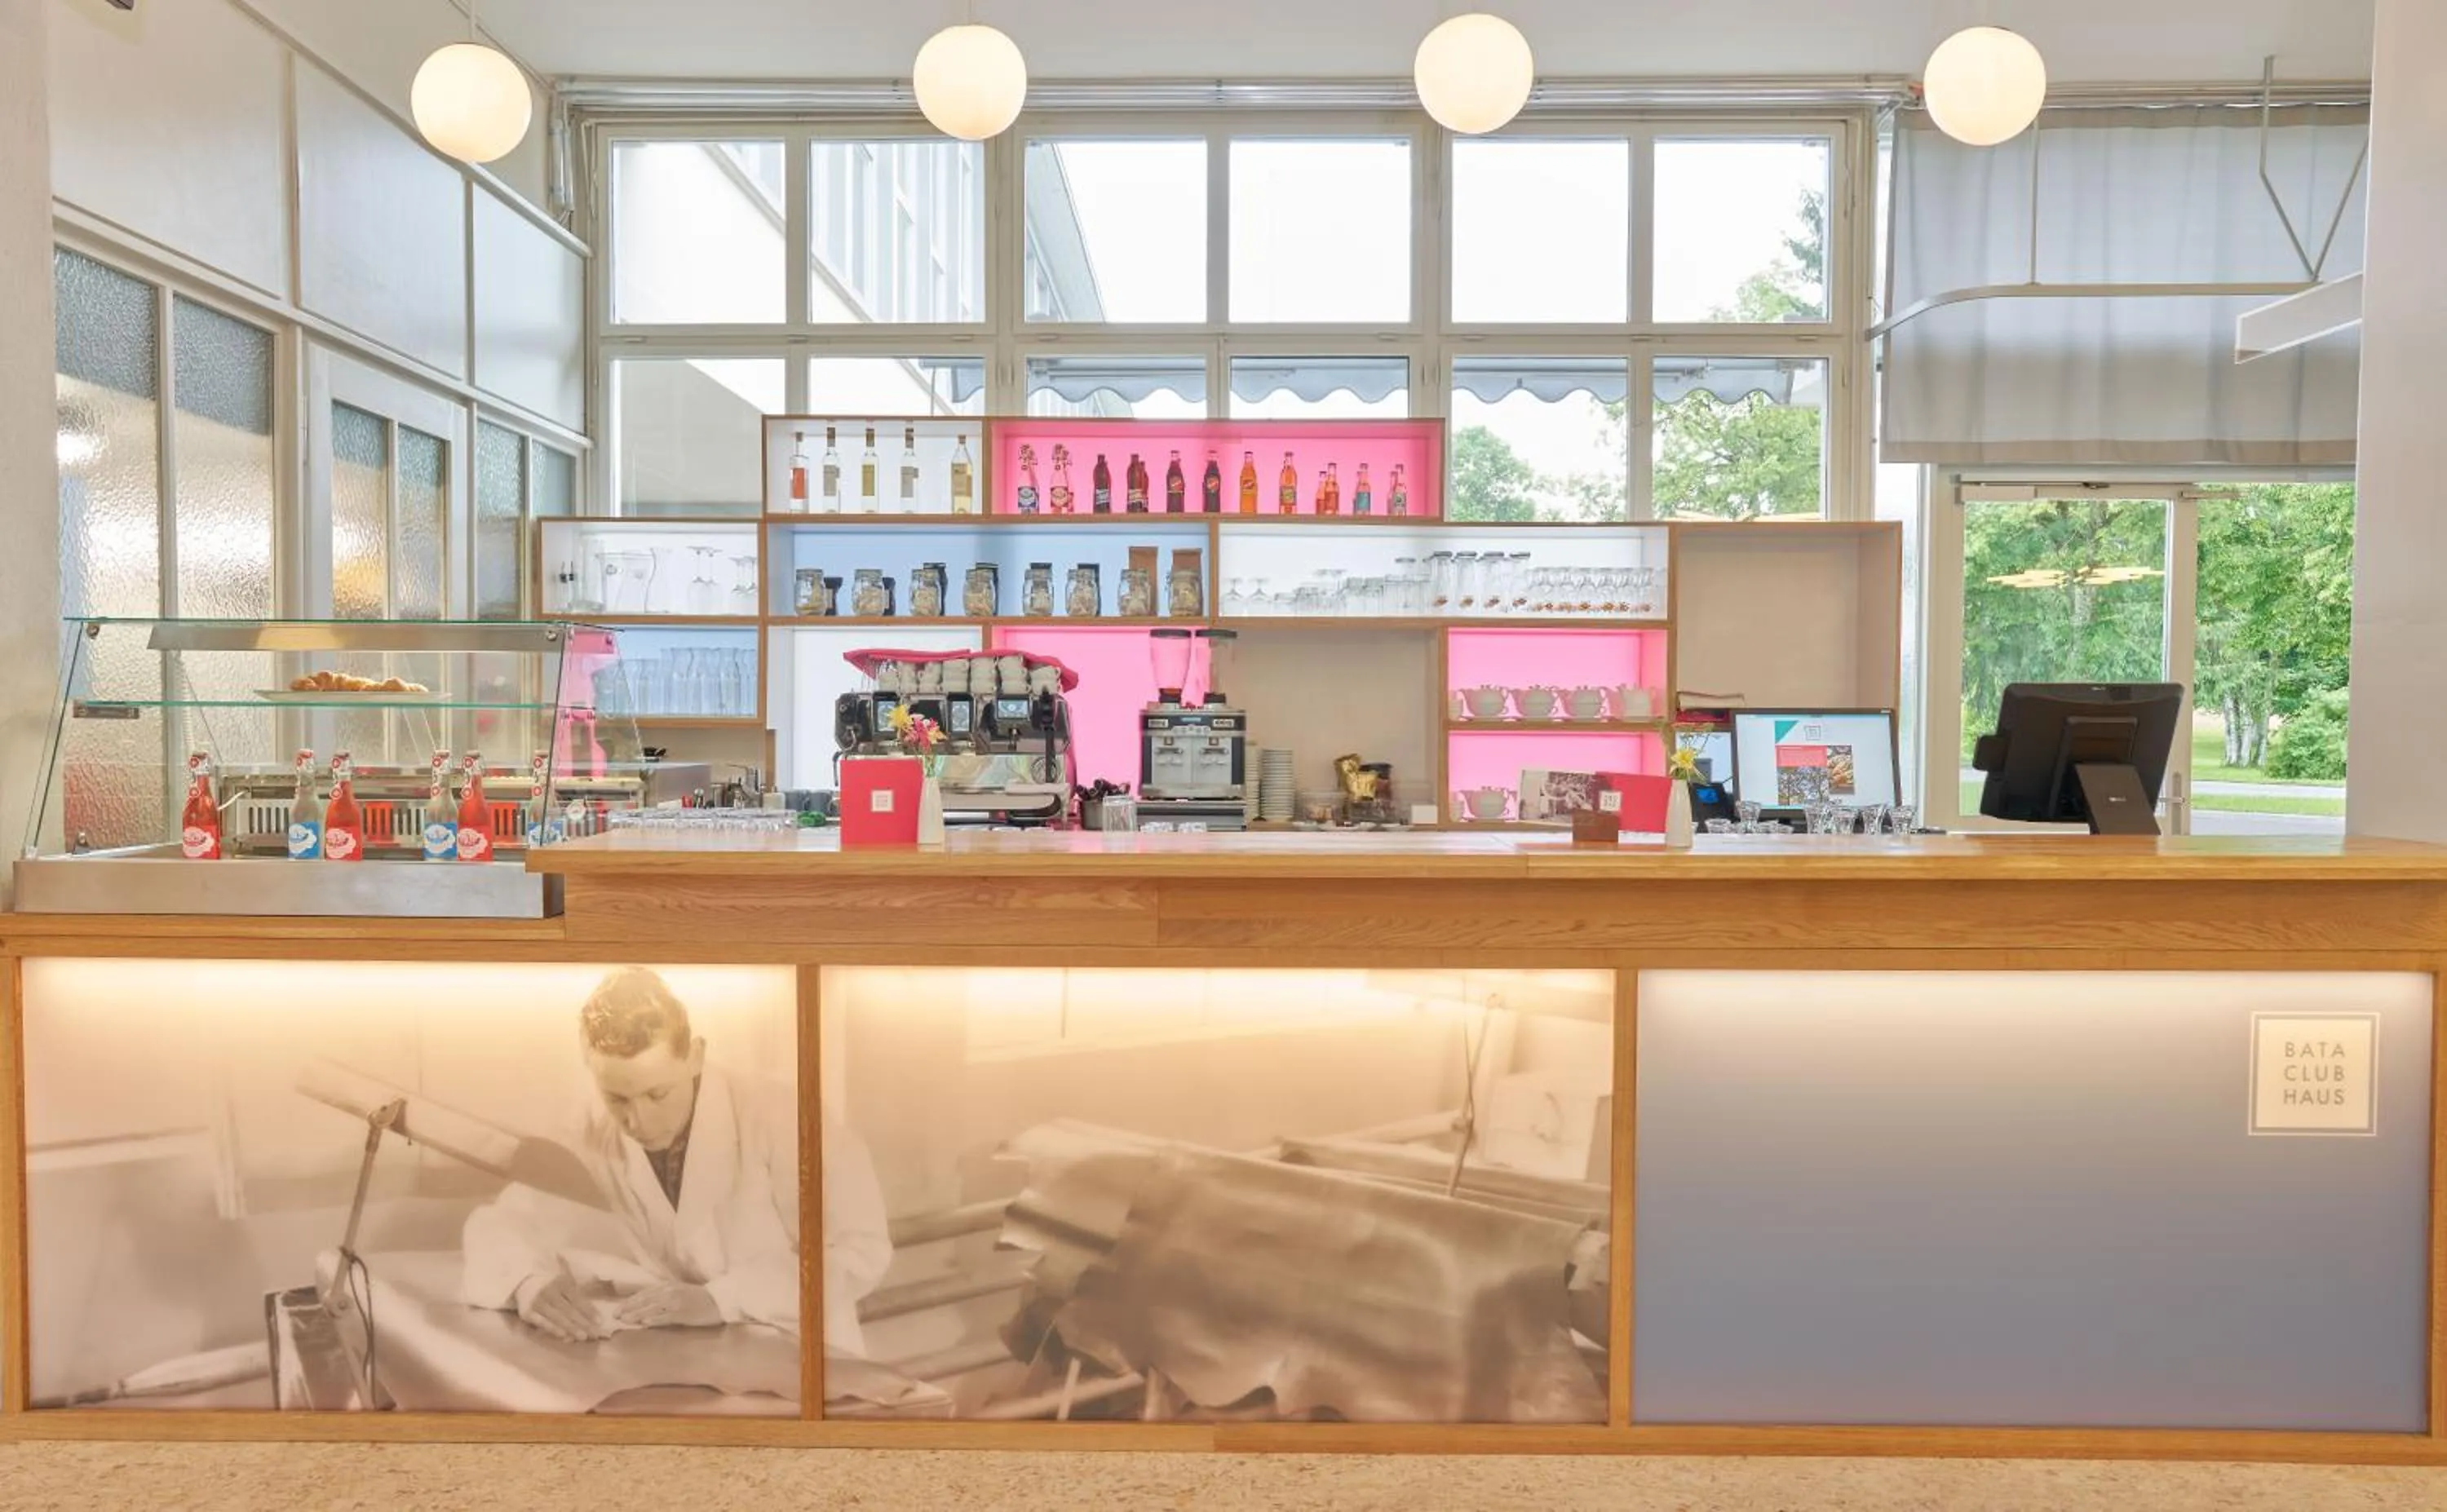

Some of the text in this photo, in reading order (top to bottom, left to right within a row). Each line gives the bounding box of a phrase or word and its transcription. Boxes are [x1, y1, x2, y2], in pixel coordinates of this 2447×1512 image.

[2284, 1041, 2346, 1059] BATA
[2283, 1064, 2346, 1082] CLUB
[2283, 1089, 2346, 1106] HAUS
